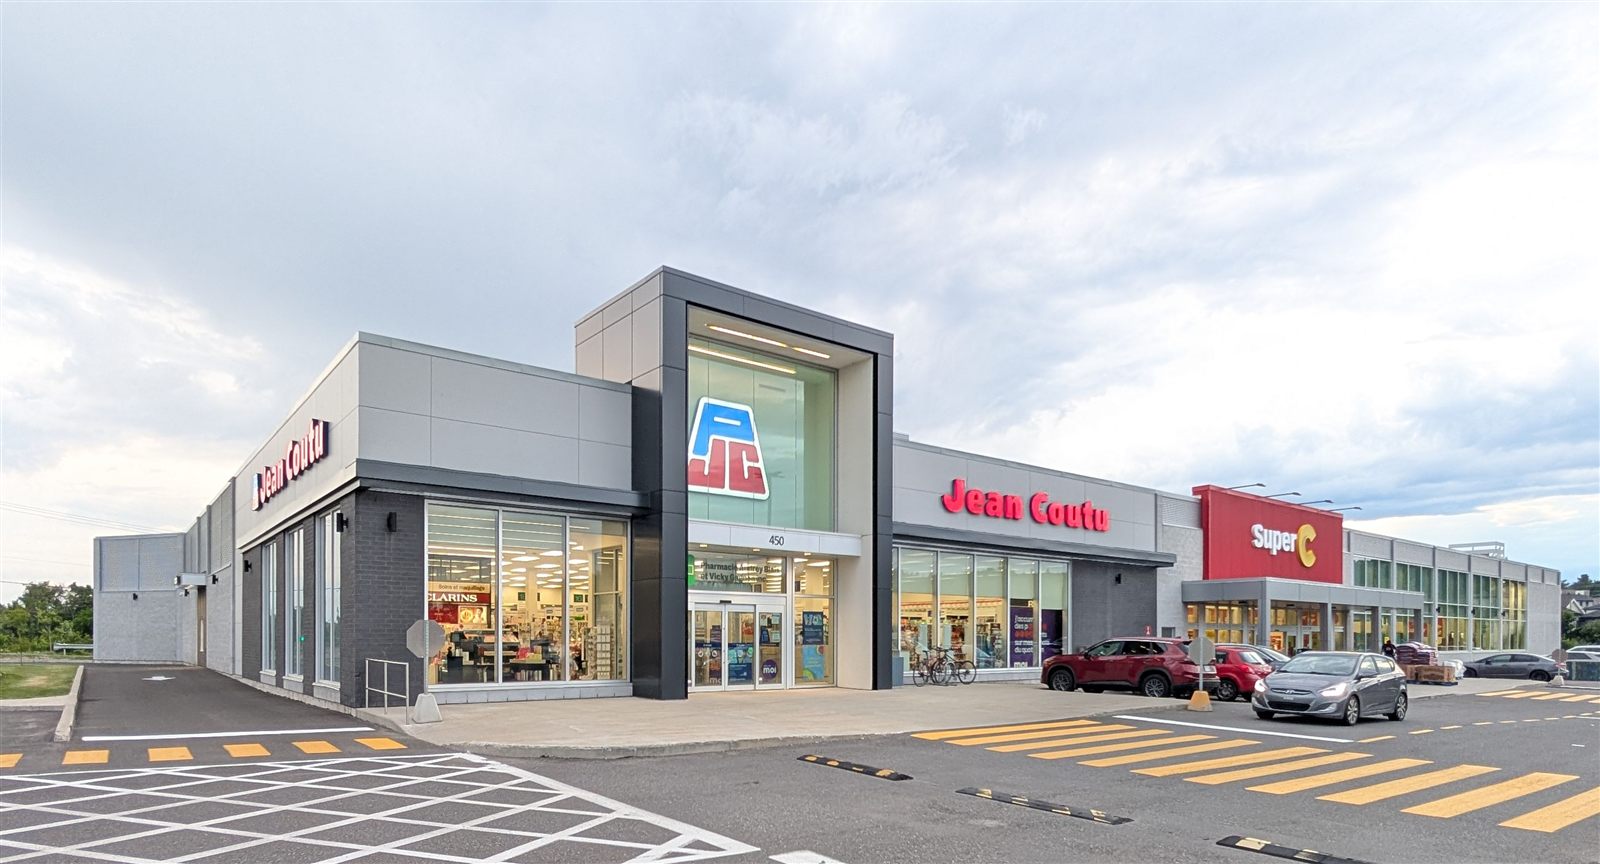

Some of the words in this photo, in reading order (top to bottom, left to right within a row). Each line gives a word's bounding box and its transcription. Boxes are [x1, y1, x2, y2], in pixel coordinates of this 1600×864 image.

[260, 459, 287, 504] Jean
[286, 419, 328, 481] Coutu
[941, 478, 1024, 520] Jean
[1030, 492, 1111, 532] Coutu
[769, 535, 785, 546] 450
[1251, 523, 1298, 555] Super
[1296, 523, 1317, 568] C
[709, 572, 729, 581] Vicky
[427, 593, 477, 602] CLARINS
[763, 666, 777, 674] moi
